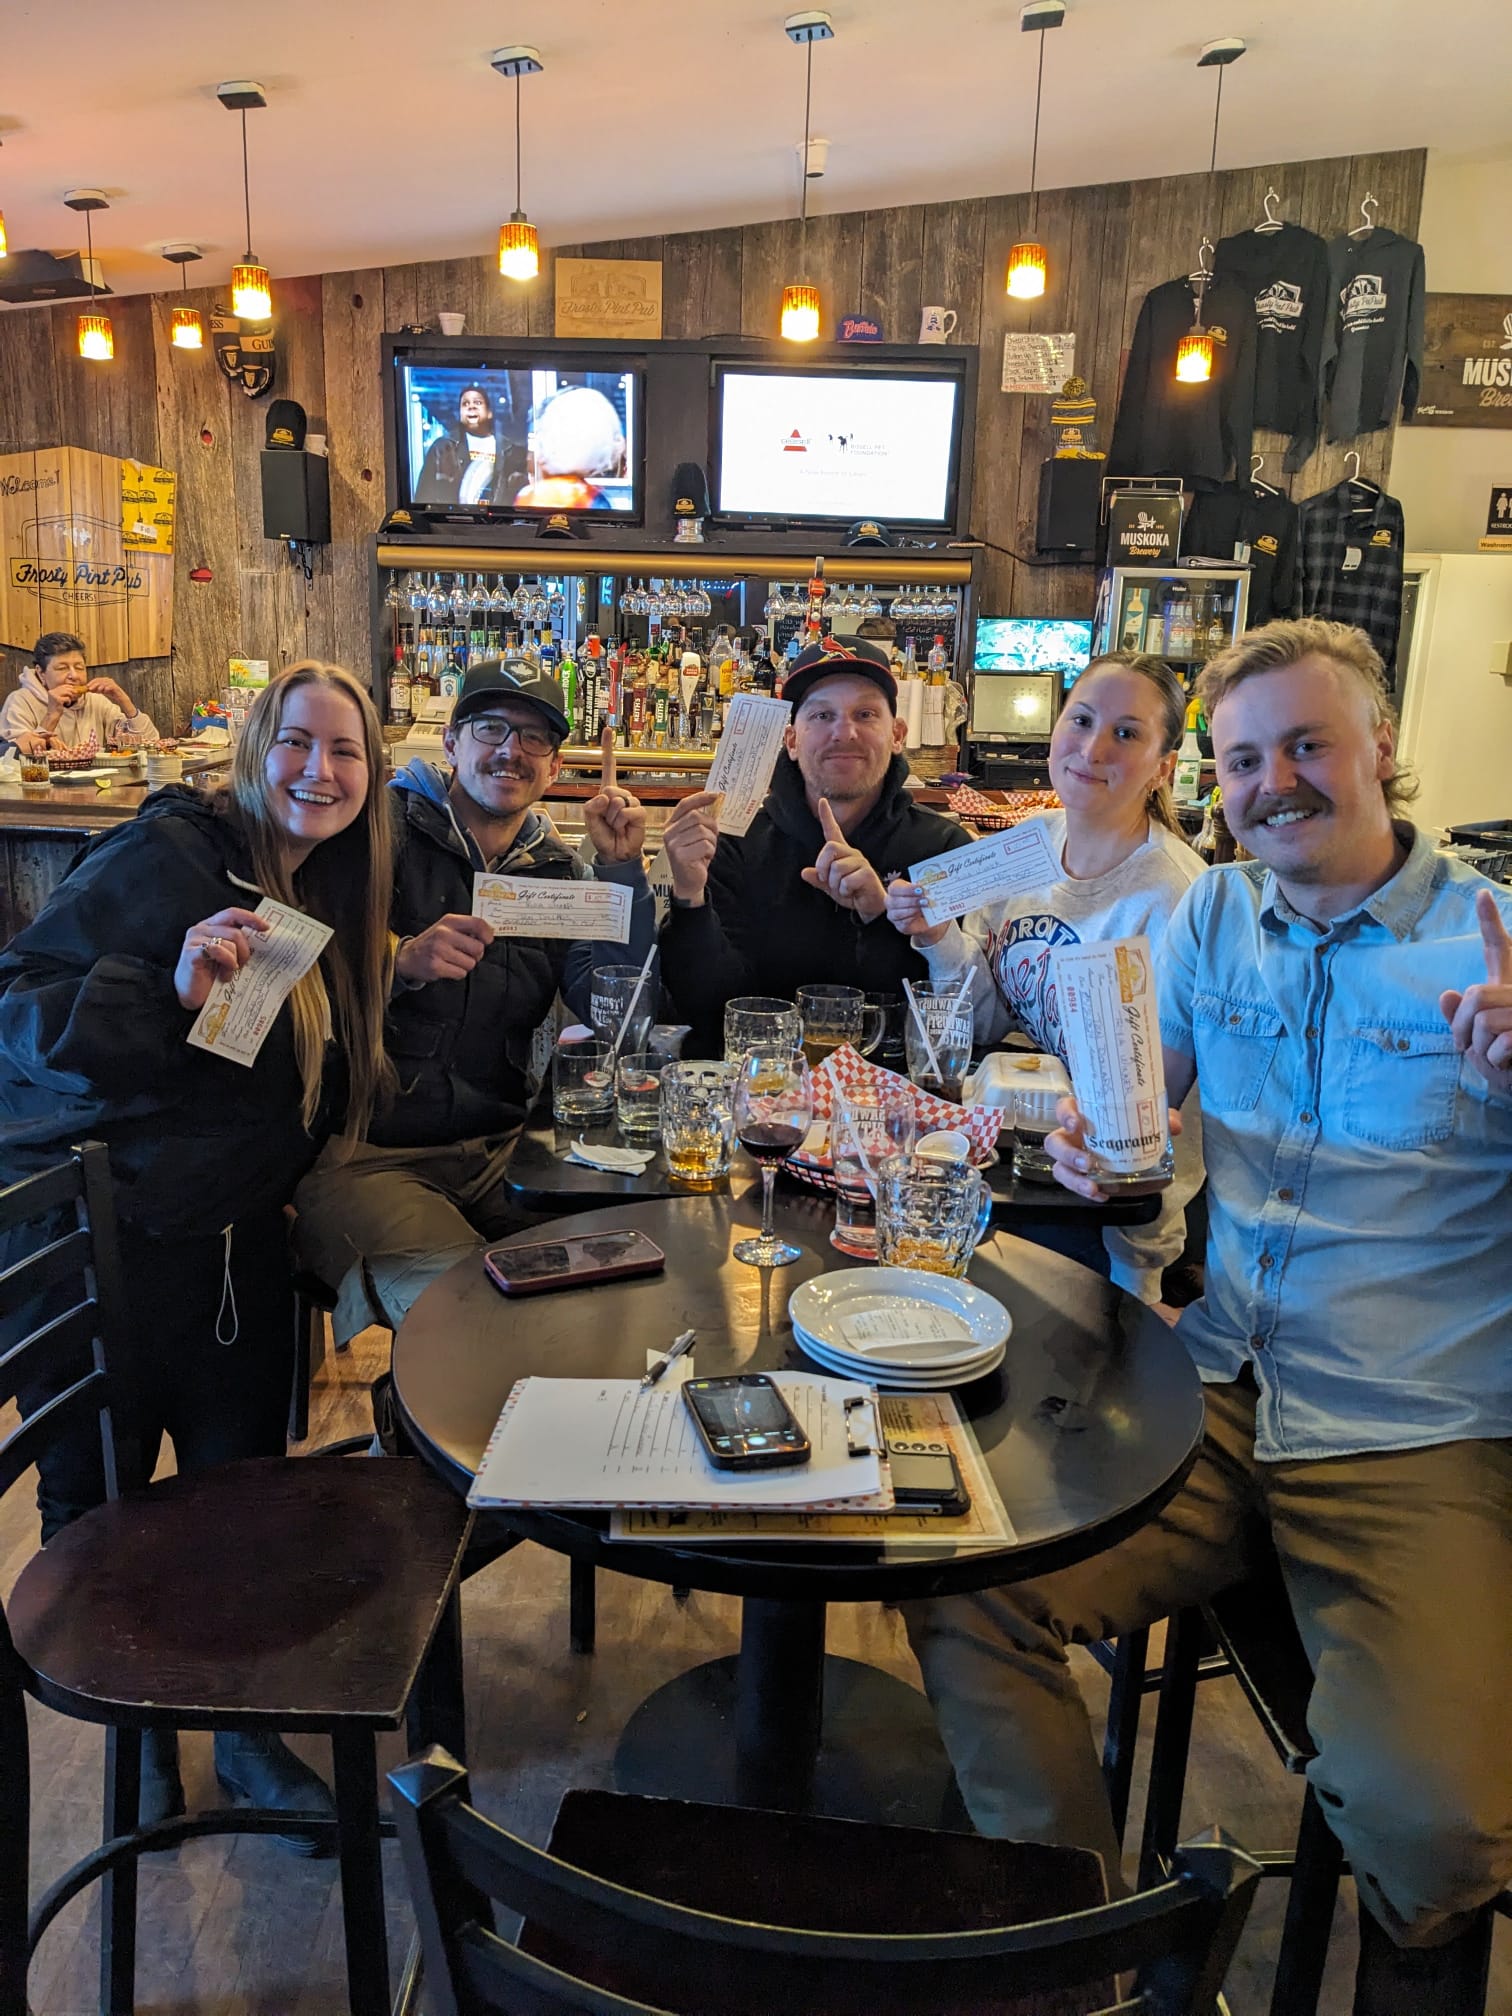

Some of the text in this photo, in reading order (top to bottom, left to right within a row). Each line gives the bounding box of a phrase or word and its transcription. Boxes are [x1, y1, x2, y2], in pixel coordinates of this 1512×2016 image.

[631, 302, 655, 316] Pub
[842, 320, 878, 339] Buffalo
[1462, 358, 1512, 387] MUS
[1120, 532, 1170, 547] MUSKOKA
[1129, 545, 1161, 558] Brewery
[16, 563, 142, 589] Frosty Pint Pub
[963, 851, 996, 869] Certificate
[517, 889, 537, 901] Gift
[537, 890, 576, 903] Certificate
[1123, 1006, 1147, 1088] Gift Certificate
